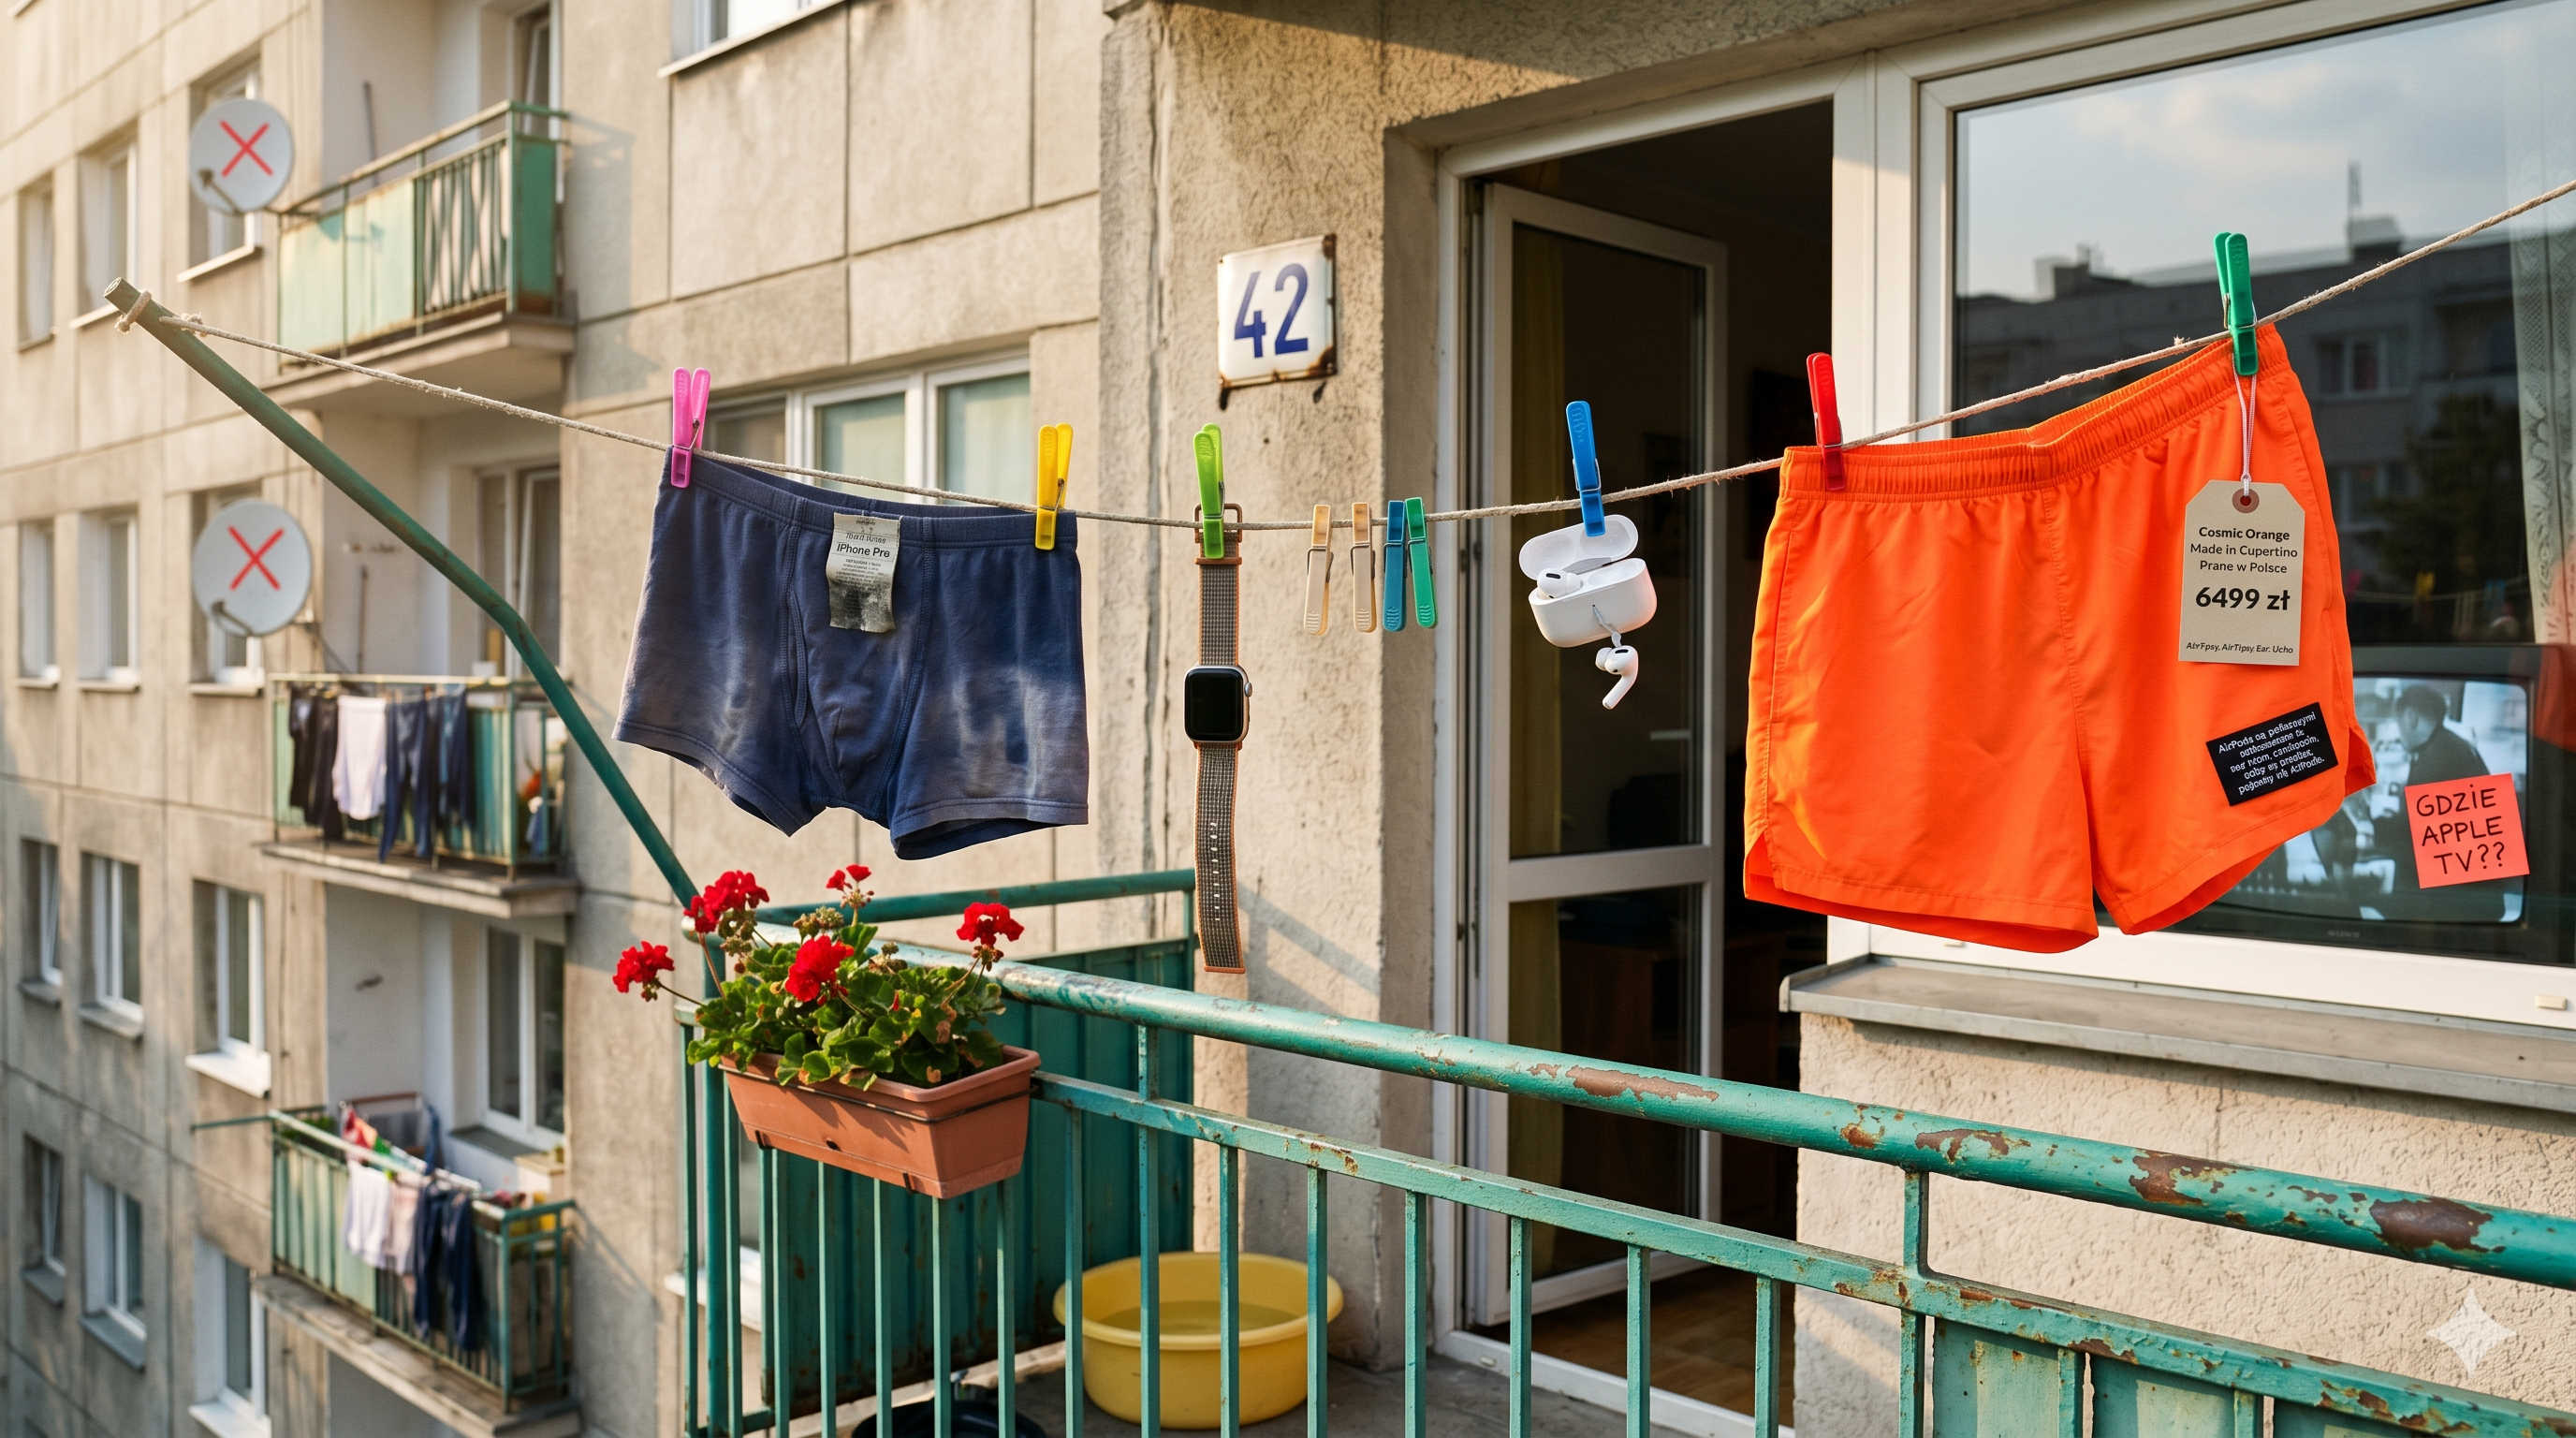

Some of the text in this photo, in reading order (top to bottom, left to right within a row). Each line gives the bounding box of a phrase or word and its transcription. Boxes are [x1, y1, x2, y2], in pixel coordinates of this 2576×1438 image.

[1234, 263, 1309, 359] 42
[2199, 526, 2291, 542] Cosmic Orange
[2190, 543, 2298, 558] Made in Cupertino
[2200, 560, 2288, 574] Prane w Polsce
[2195, 586, 2291, 610] 6499 zł
[2272, 645, 2293, 653] Ucho
[2422, 815, 2504, 846] APPLE
